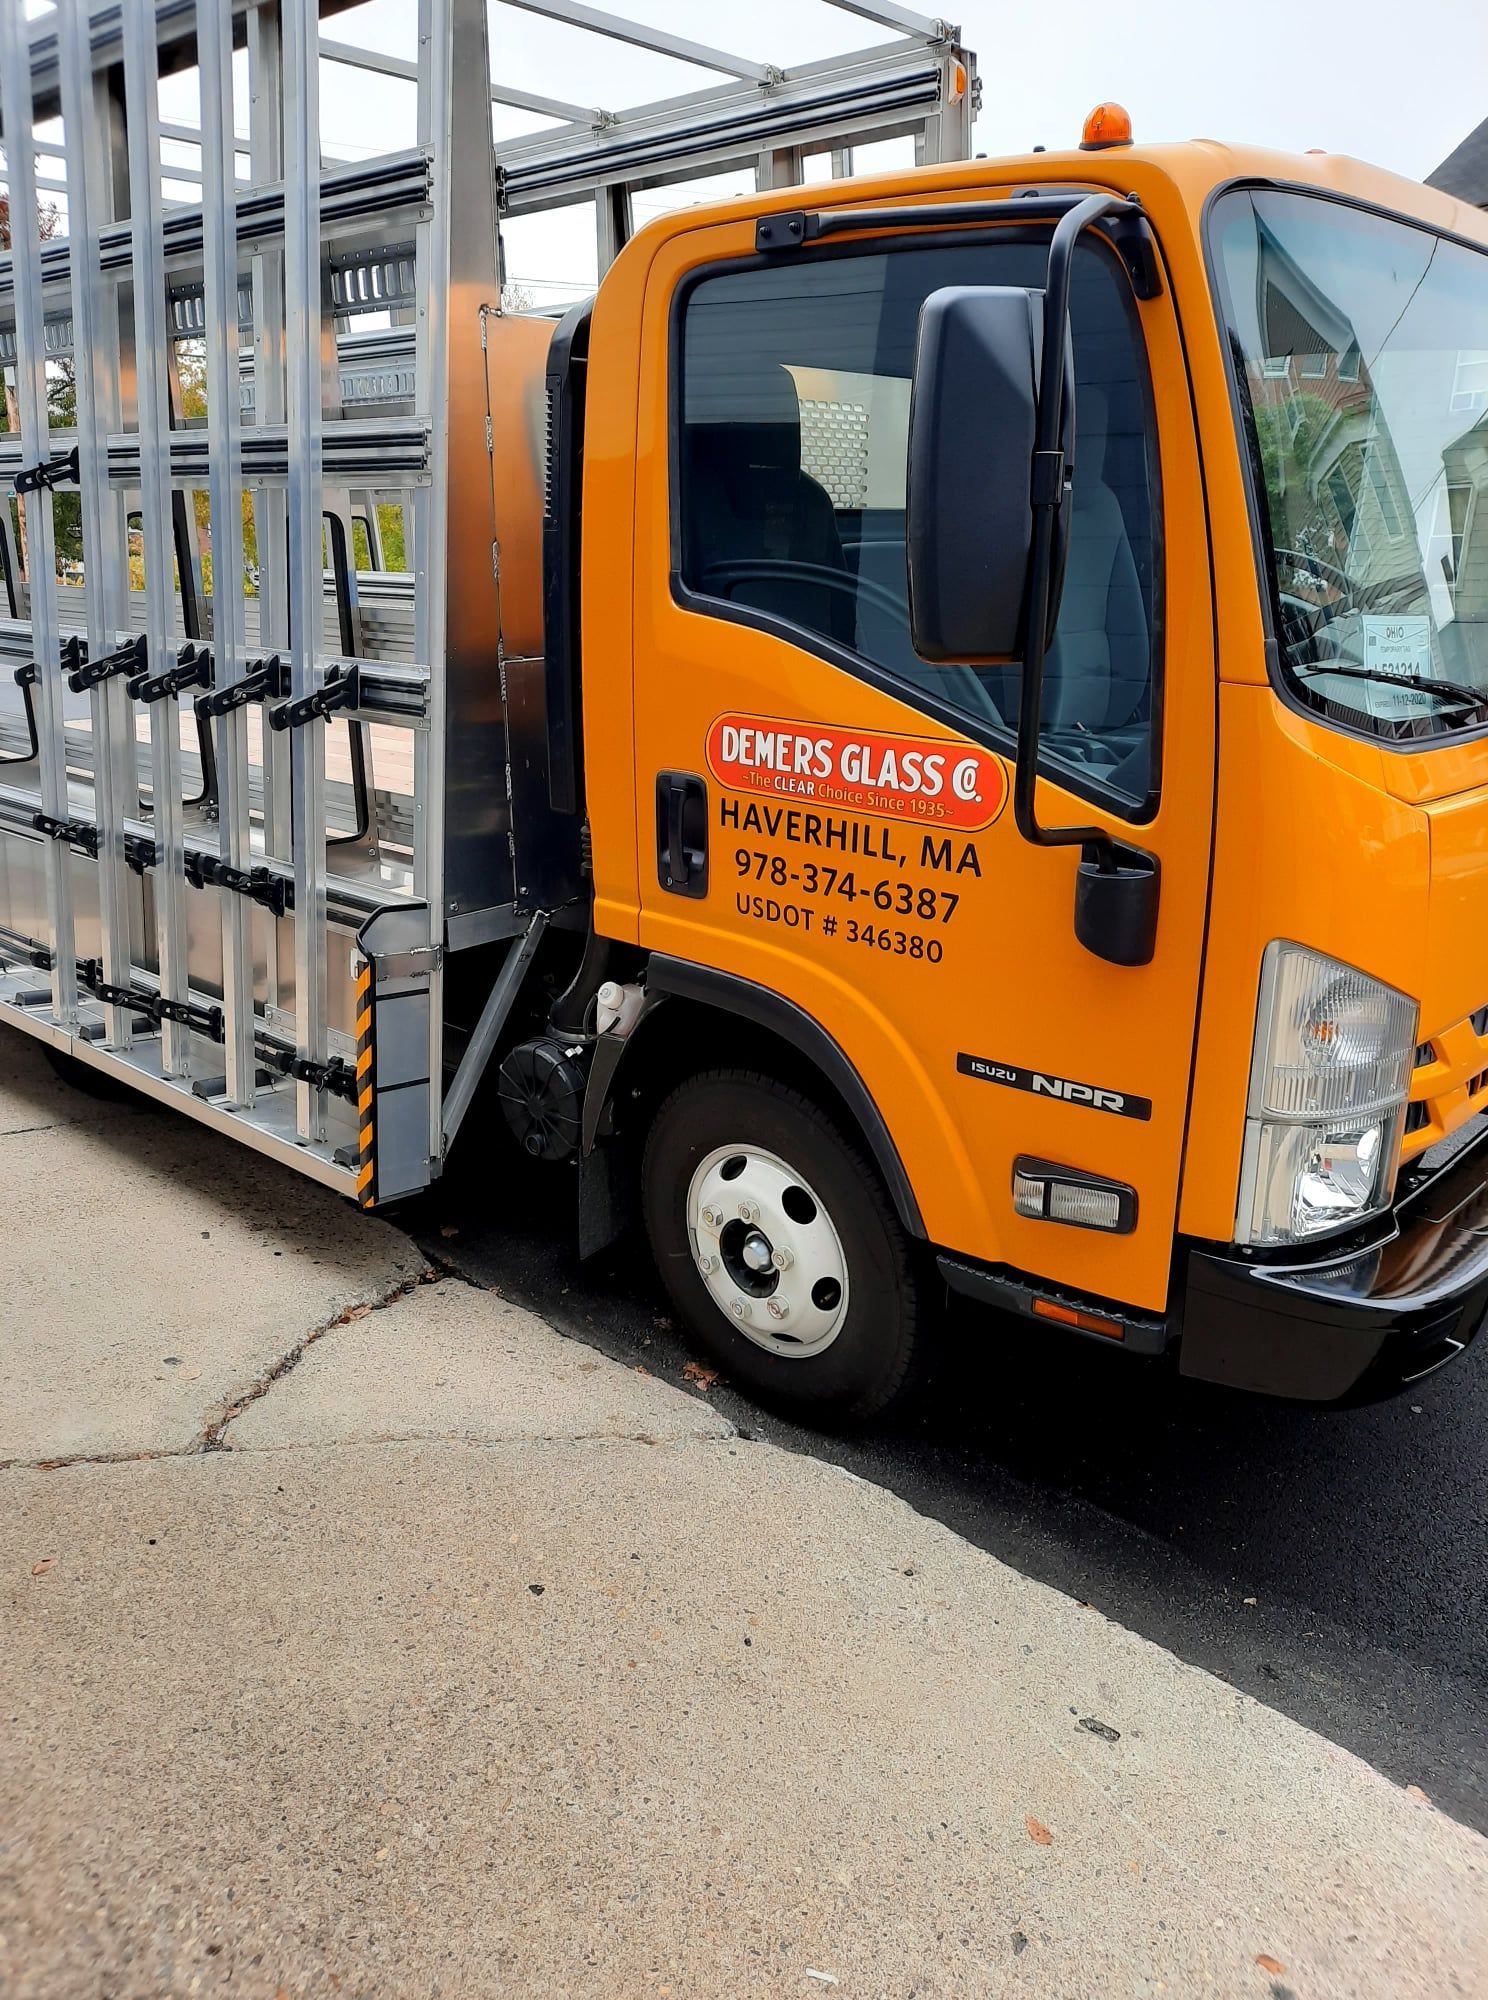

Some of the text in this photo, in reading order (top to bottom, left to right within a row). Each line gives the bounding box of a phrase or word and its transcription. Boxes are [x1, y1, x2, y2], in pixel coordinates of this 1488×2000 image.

[1386, 627, 1404, 638] OHIO
[722, 725, 833, 778] DEMERS
[840, 744, 945, 796] GLASS
[773, 776, 815, 796] CLEAR
[817, 783, 863, 804] Choice
[866, 791, 905, 811] Since
[720, 798, 982, 878] HAVERHILL, MA
[734, 848, 960, 924] 978-374-6387
[736, 892, 943, 964] USDOT # 346380
[971, 1061, 1124, 1113] ISUZU NPR
